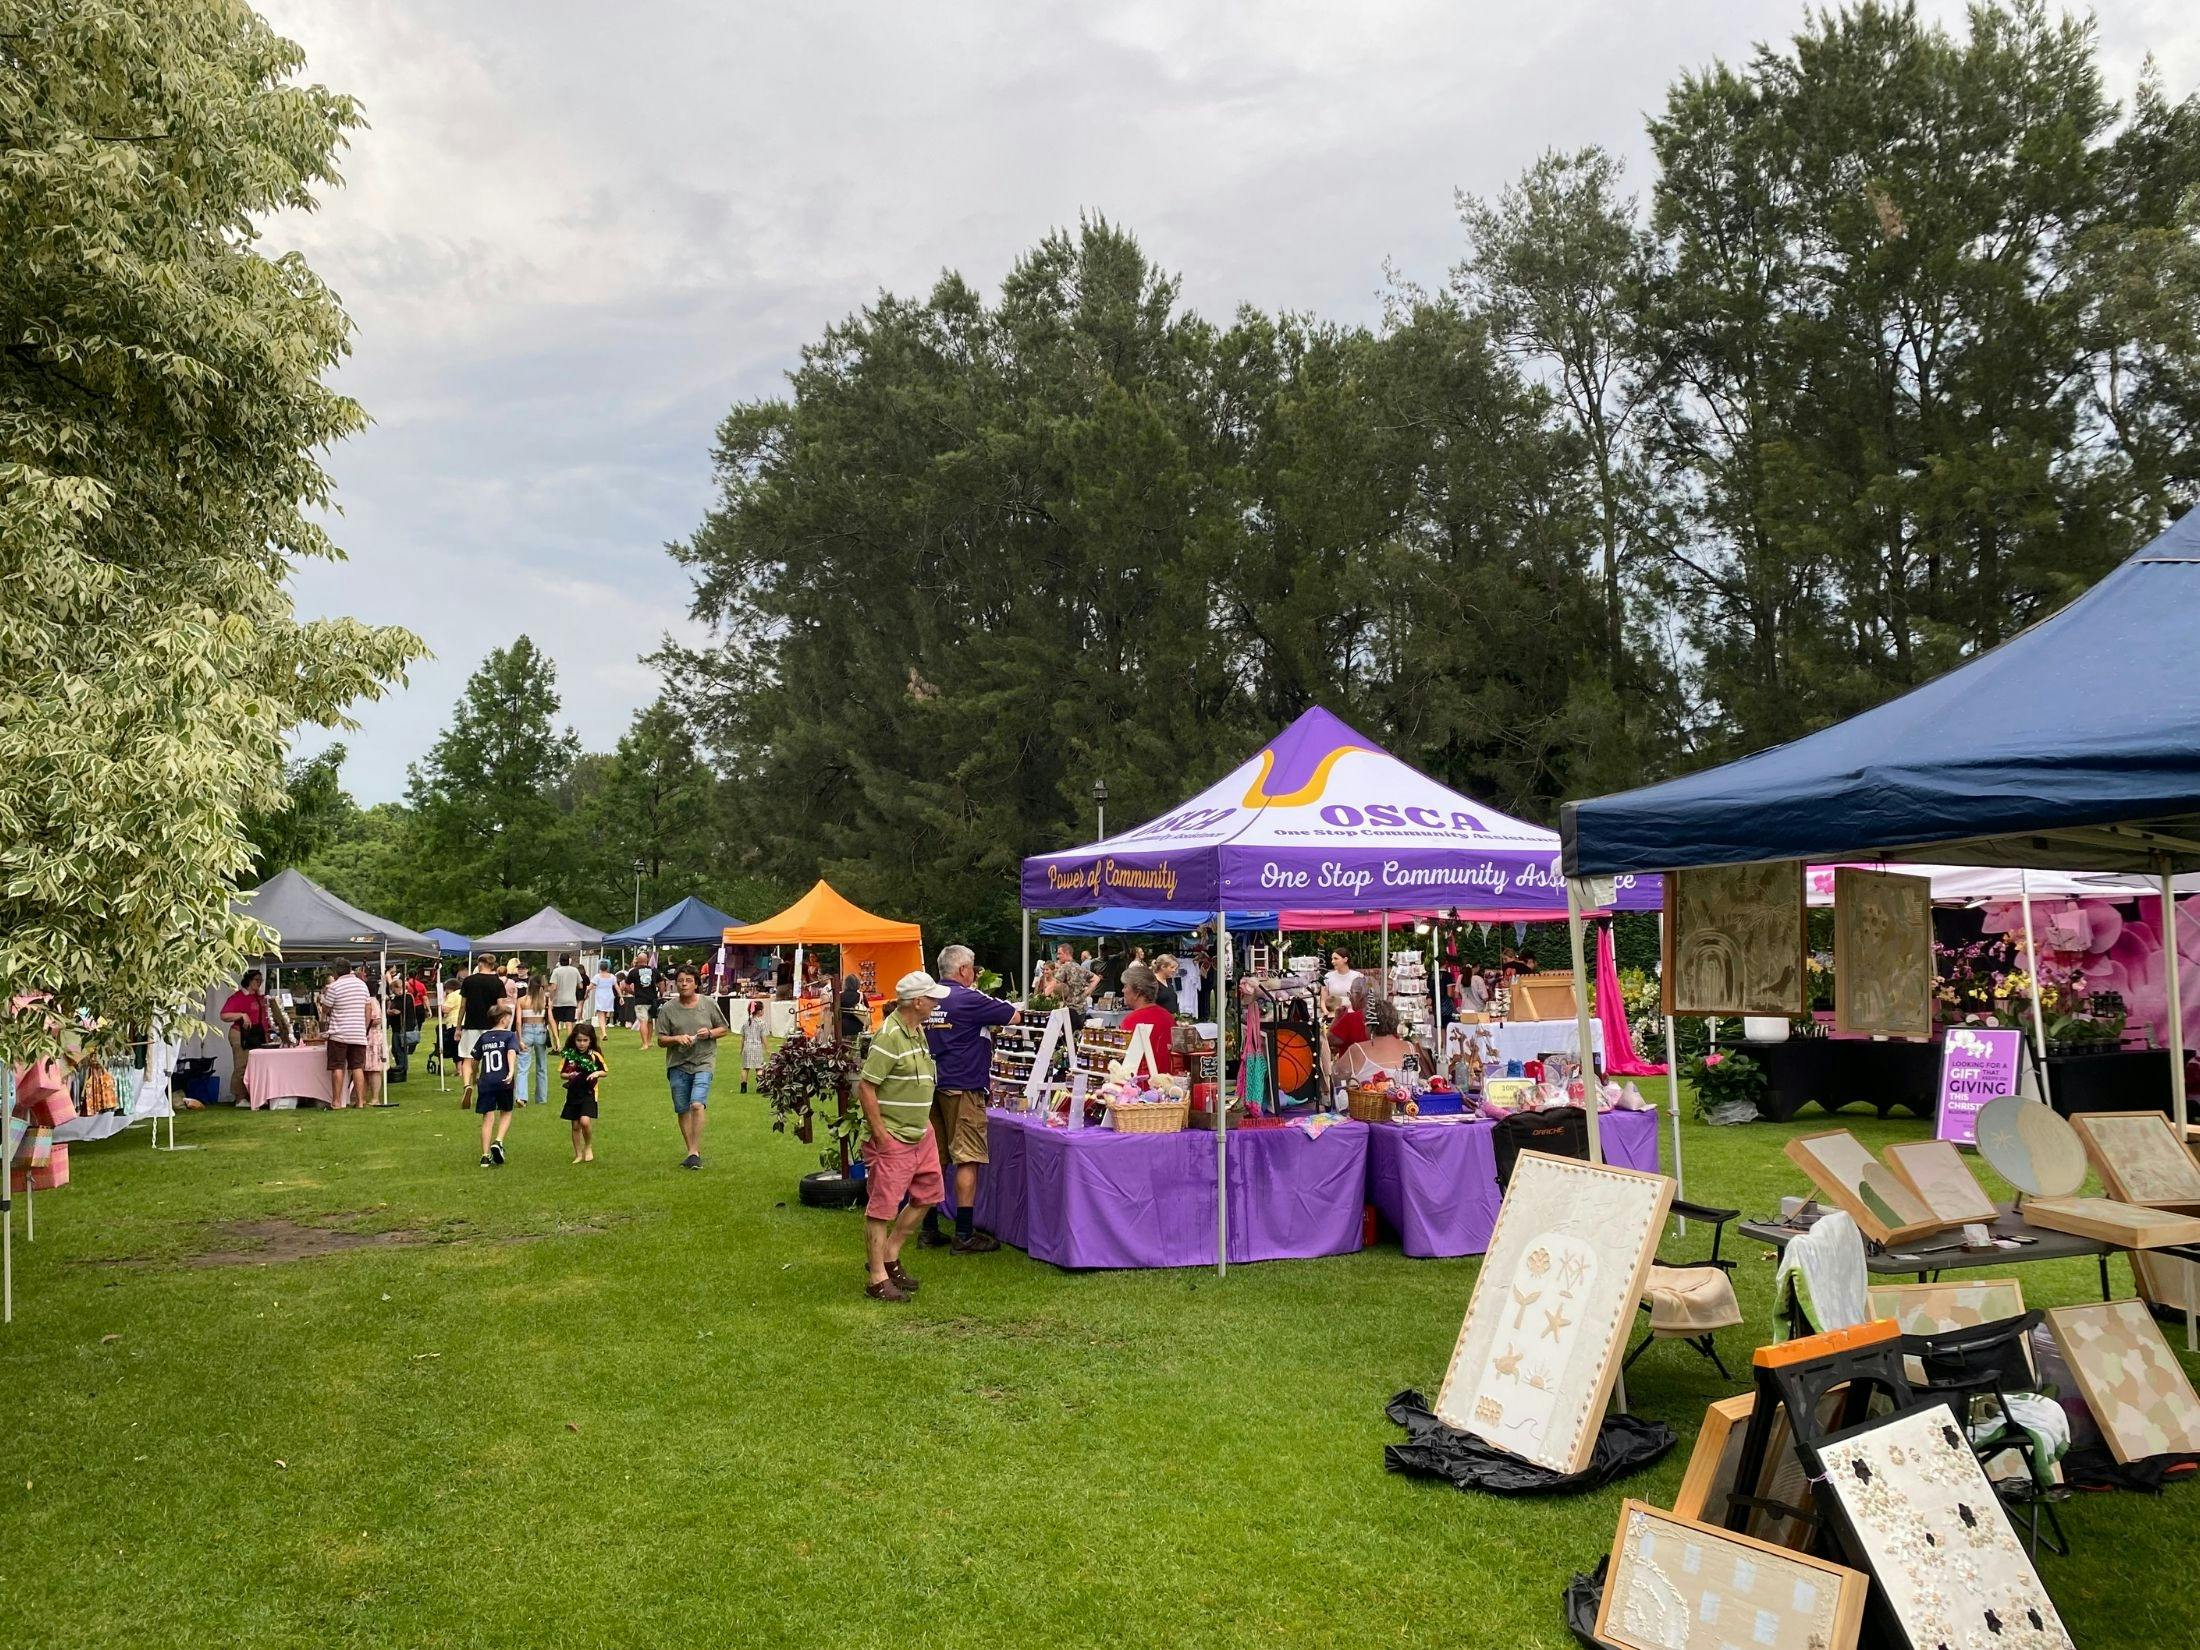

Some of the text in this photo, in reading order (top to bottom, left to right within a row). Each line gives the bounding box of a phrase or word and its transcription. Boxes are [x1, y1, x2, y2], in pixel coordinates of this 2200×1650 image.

[1320, 804, 1490, 832] OSCA
[1314, 828, 1359, 838] Stop
[1361, 829, 1469, 840] Community
[1047, 858, 1178, 900] Power of Community
[1260, 861, 1311, 889] One
[1317, 860, 1374, 897] Stop
[1382, 860, 1510, 895] Community
[484, 1050, 503, 1073] 10
[1950, 1067, 1980, 1079] GIFT
[1949, 1080, 2006, 1095] GIVING
[1949, 1093, 1969, 1101] THIS
[1948, 1101, 1984, 1111] CHRIST
